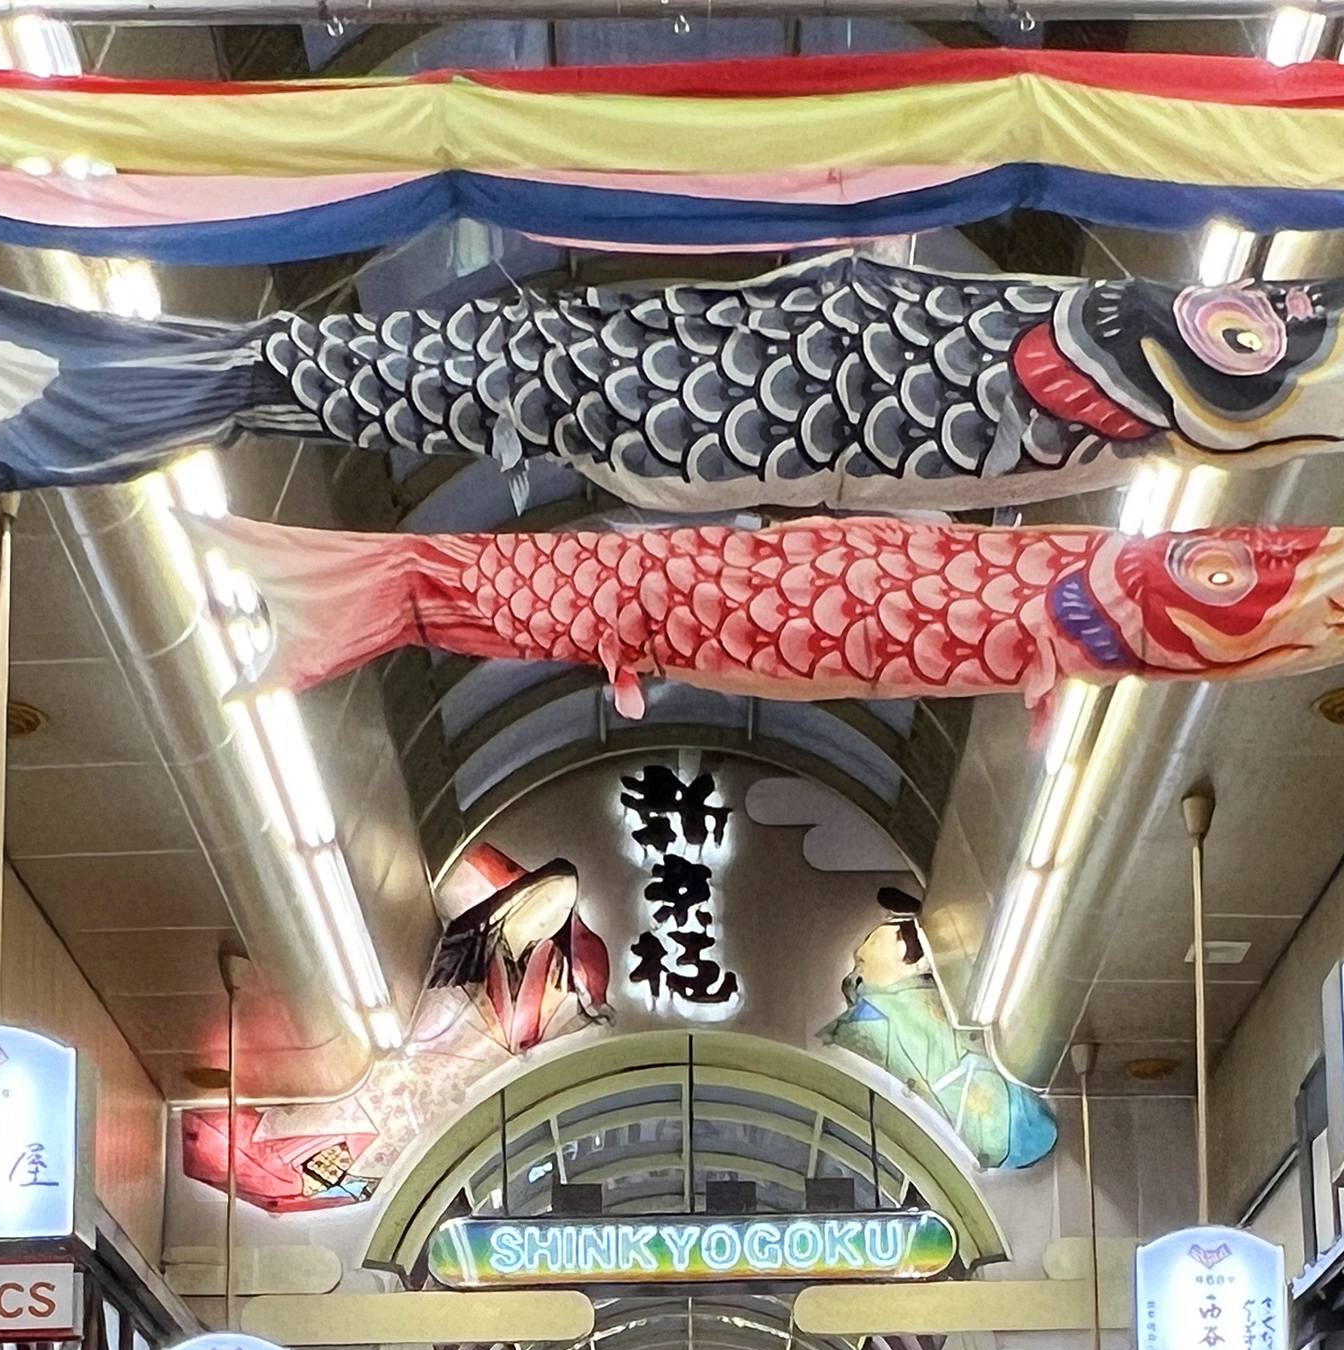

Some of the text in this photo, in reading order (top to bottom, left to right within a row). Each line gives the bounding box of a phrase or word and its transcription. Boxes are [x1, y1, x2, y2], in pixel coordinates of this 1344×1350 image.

[619, 765, 739, 1005] 新京極
[488, 1219, 904, 1272] SHINKYOGOKU
